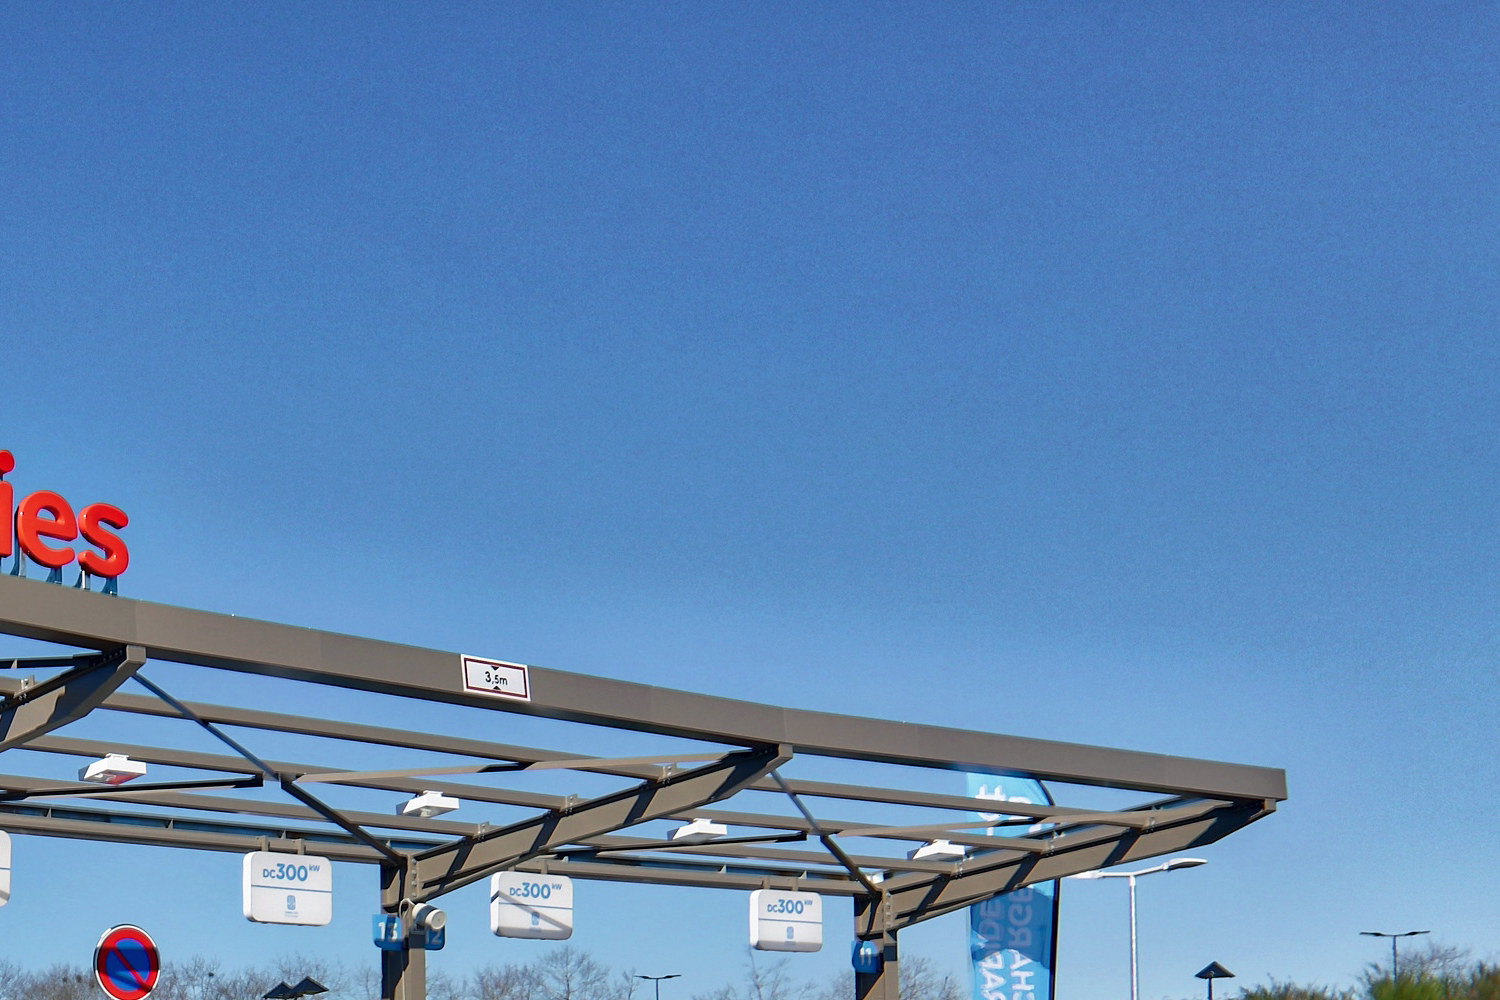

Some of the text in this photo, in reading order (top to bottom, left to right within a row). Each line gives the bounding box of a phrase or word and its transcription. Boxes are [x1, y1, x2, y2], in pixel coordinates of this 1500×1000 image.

[485, 671, 508, 685] 3,5m
[379, 922, 398, 942] 13
[860, 948, 872, 966] 11
